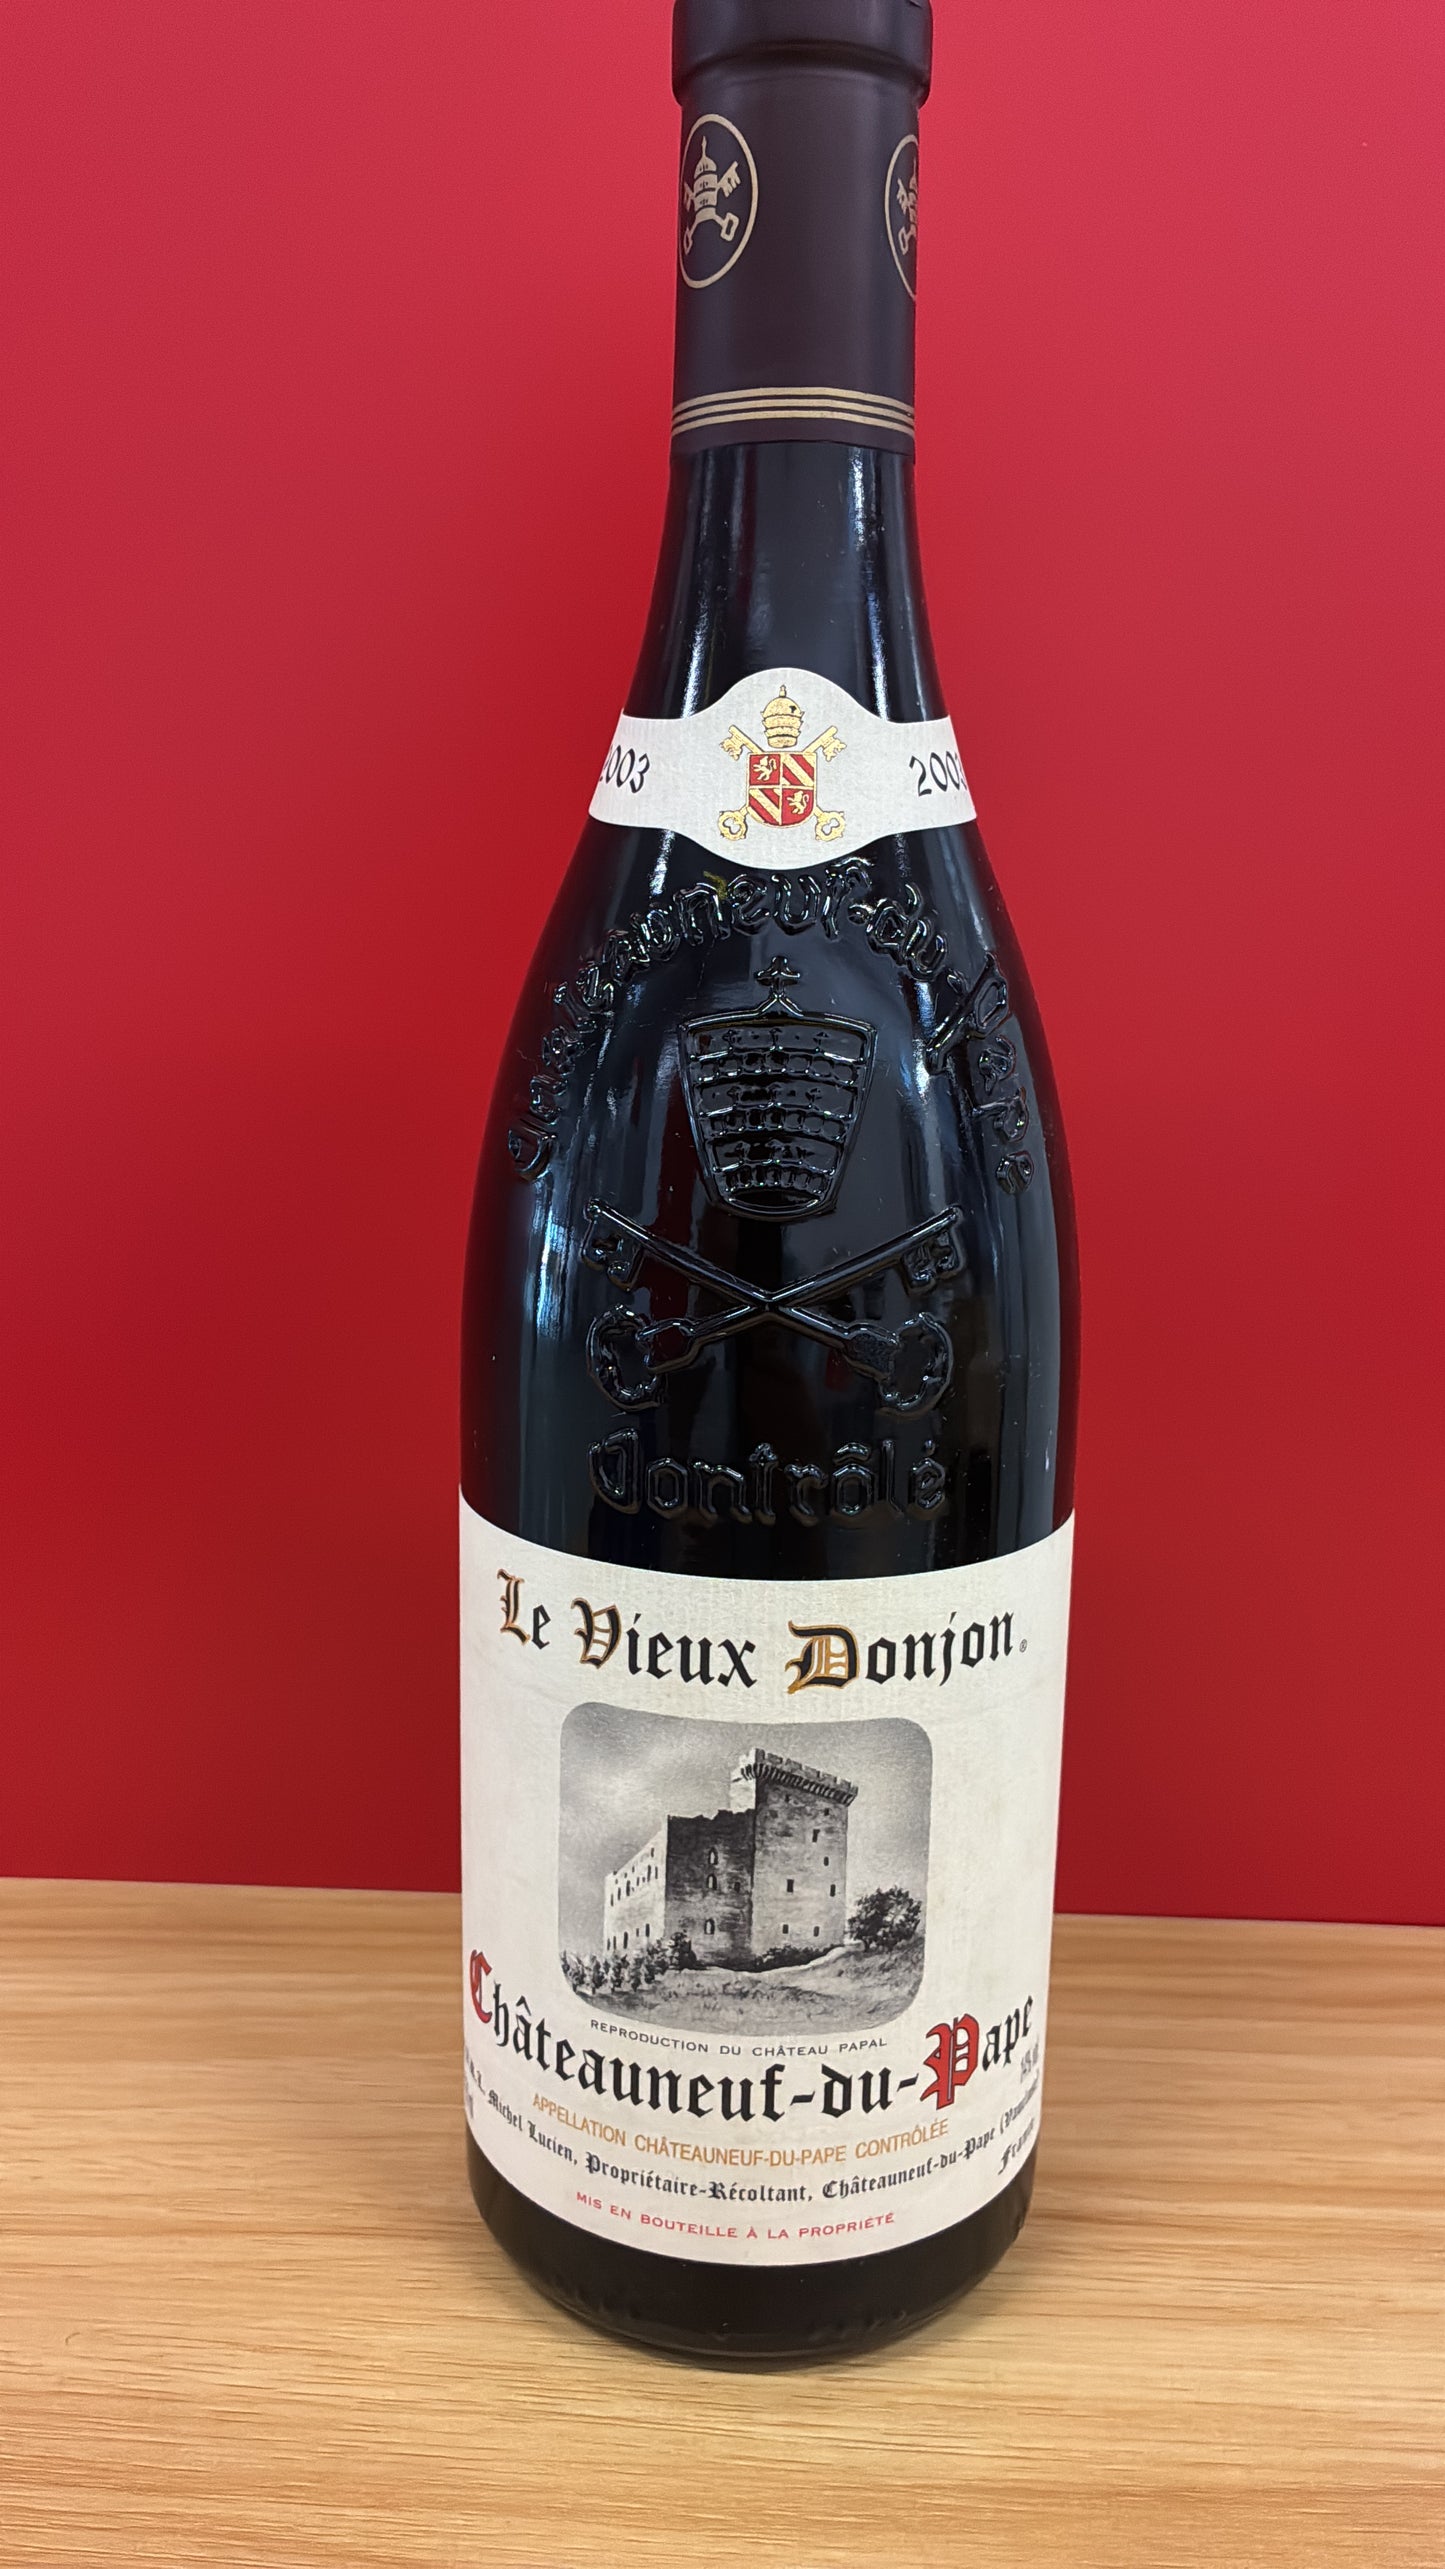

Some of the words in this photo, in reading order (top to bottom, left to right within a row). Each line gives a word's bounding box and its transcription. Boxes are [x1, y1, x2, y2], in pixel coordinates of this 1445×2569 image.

[497, 1568, 551, 1649] Le
[571, 1597, 757, 1688] Vieux
[470, 1949, 1033, 2123] Châteauneuf-du-Pape
[590, 2019, 709, 2053] REPRODUCTION
[719, 2045, 741, 2056] DU
[752, 2045, 828, 2057] CHÂTEAU
[839, 2037, 888, 2052] PAPAL
[488, 2089, 523, 2132] Michel
[527, 2120, 578, 2166] Lucien,
[585, 2151, 813, 2203] Propriétaire-Récoltant,
[822, 2127, 995, 2200] Châteauneuf-du-Pape
[532, 2093, 626, 2147] APPELLATION
[634, 2134, 847, 2168] CHÂTEAUNEUF-DU-PAPE
[855, 2117, 949, 2160] CONTRÔLÉE
[576, 2191, 602, 2210] MIS
[610, 2205, 632, 2220] EN
[640, 2213, 738, 2239] BOUTEILLE
[746, 2226, 758, 2239] À
[767, 2228, 789, 2240] LA
[799, 2212, 895, 2238] PROPRIÉTÉ
